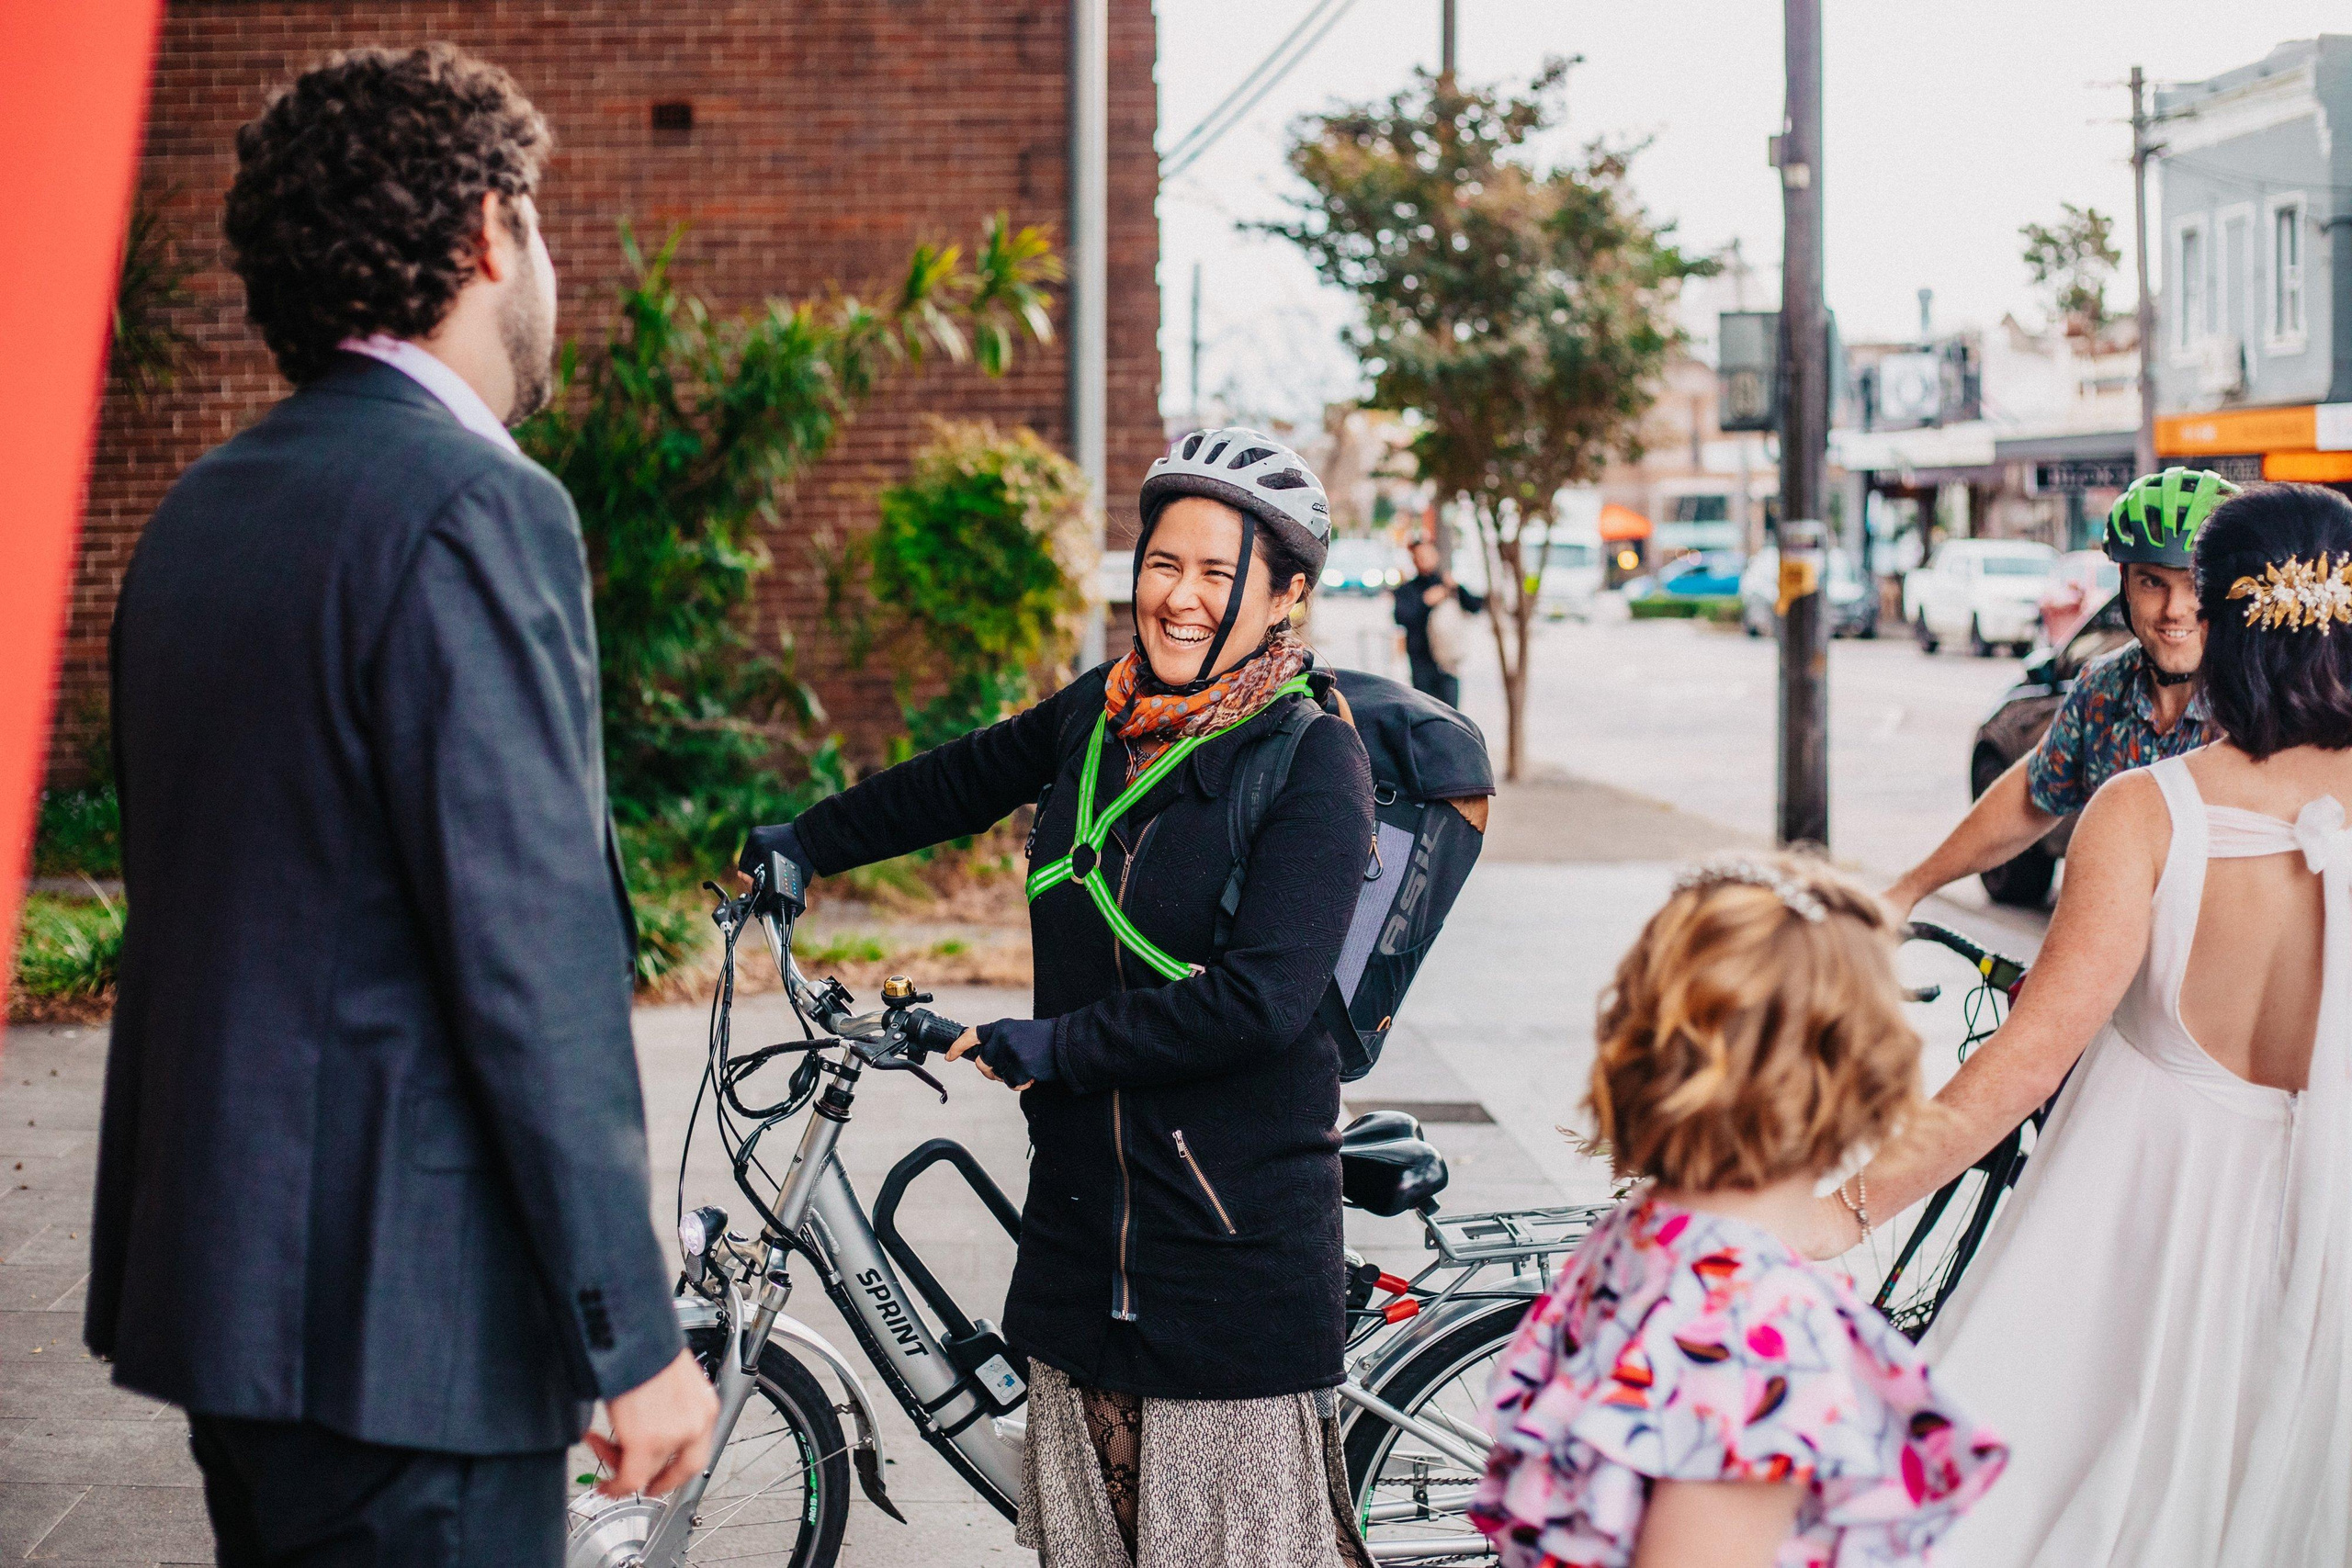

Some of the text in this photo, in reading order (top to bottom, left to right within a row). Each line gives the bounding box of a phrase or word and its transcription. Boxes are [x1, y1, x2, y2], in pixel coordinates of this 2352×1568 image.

[1380, 816, 1449, 954] ASIL
[855, 1268, 930, 1357] SPRINT
[808, 1506, 817, 1523] PRO
